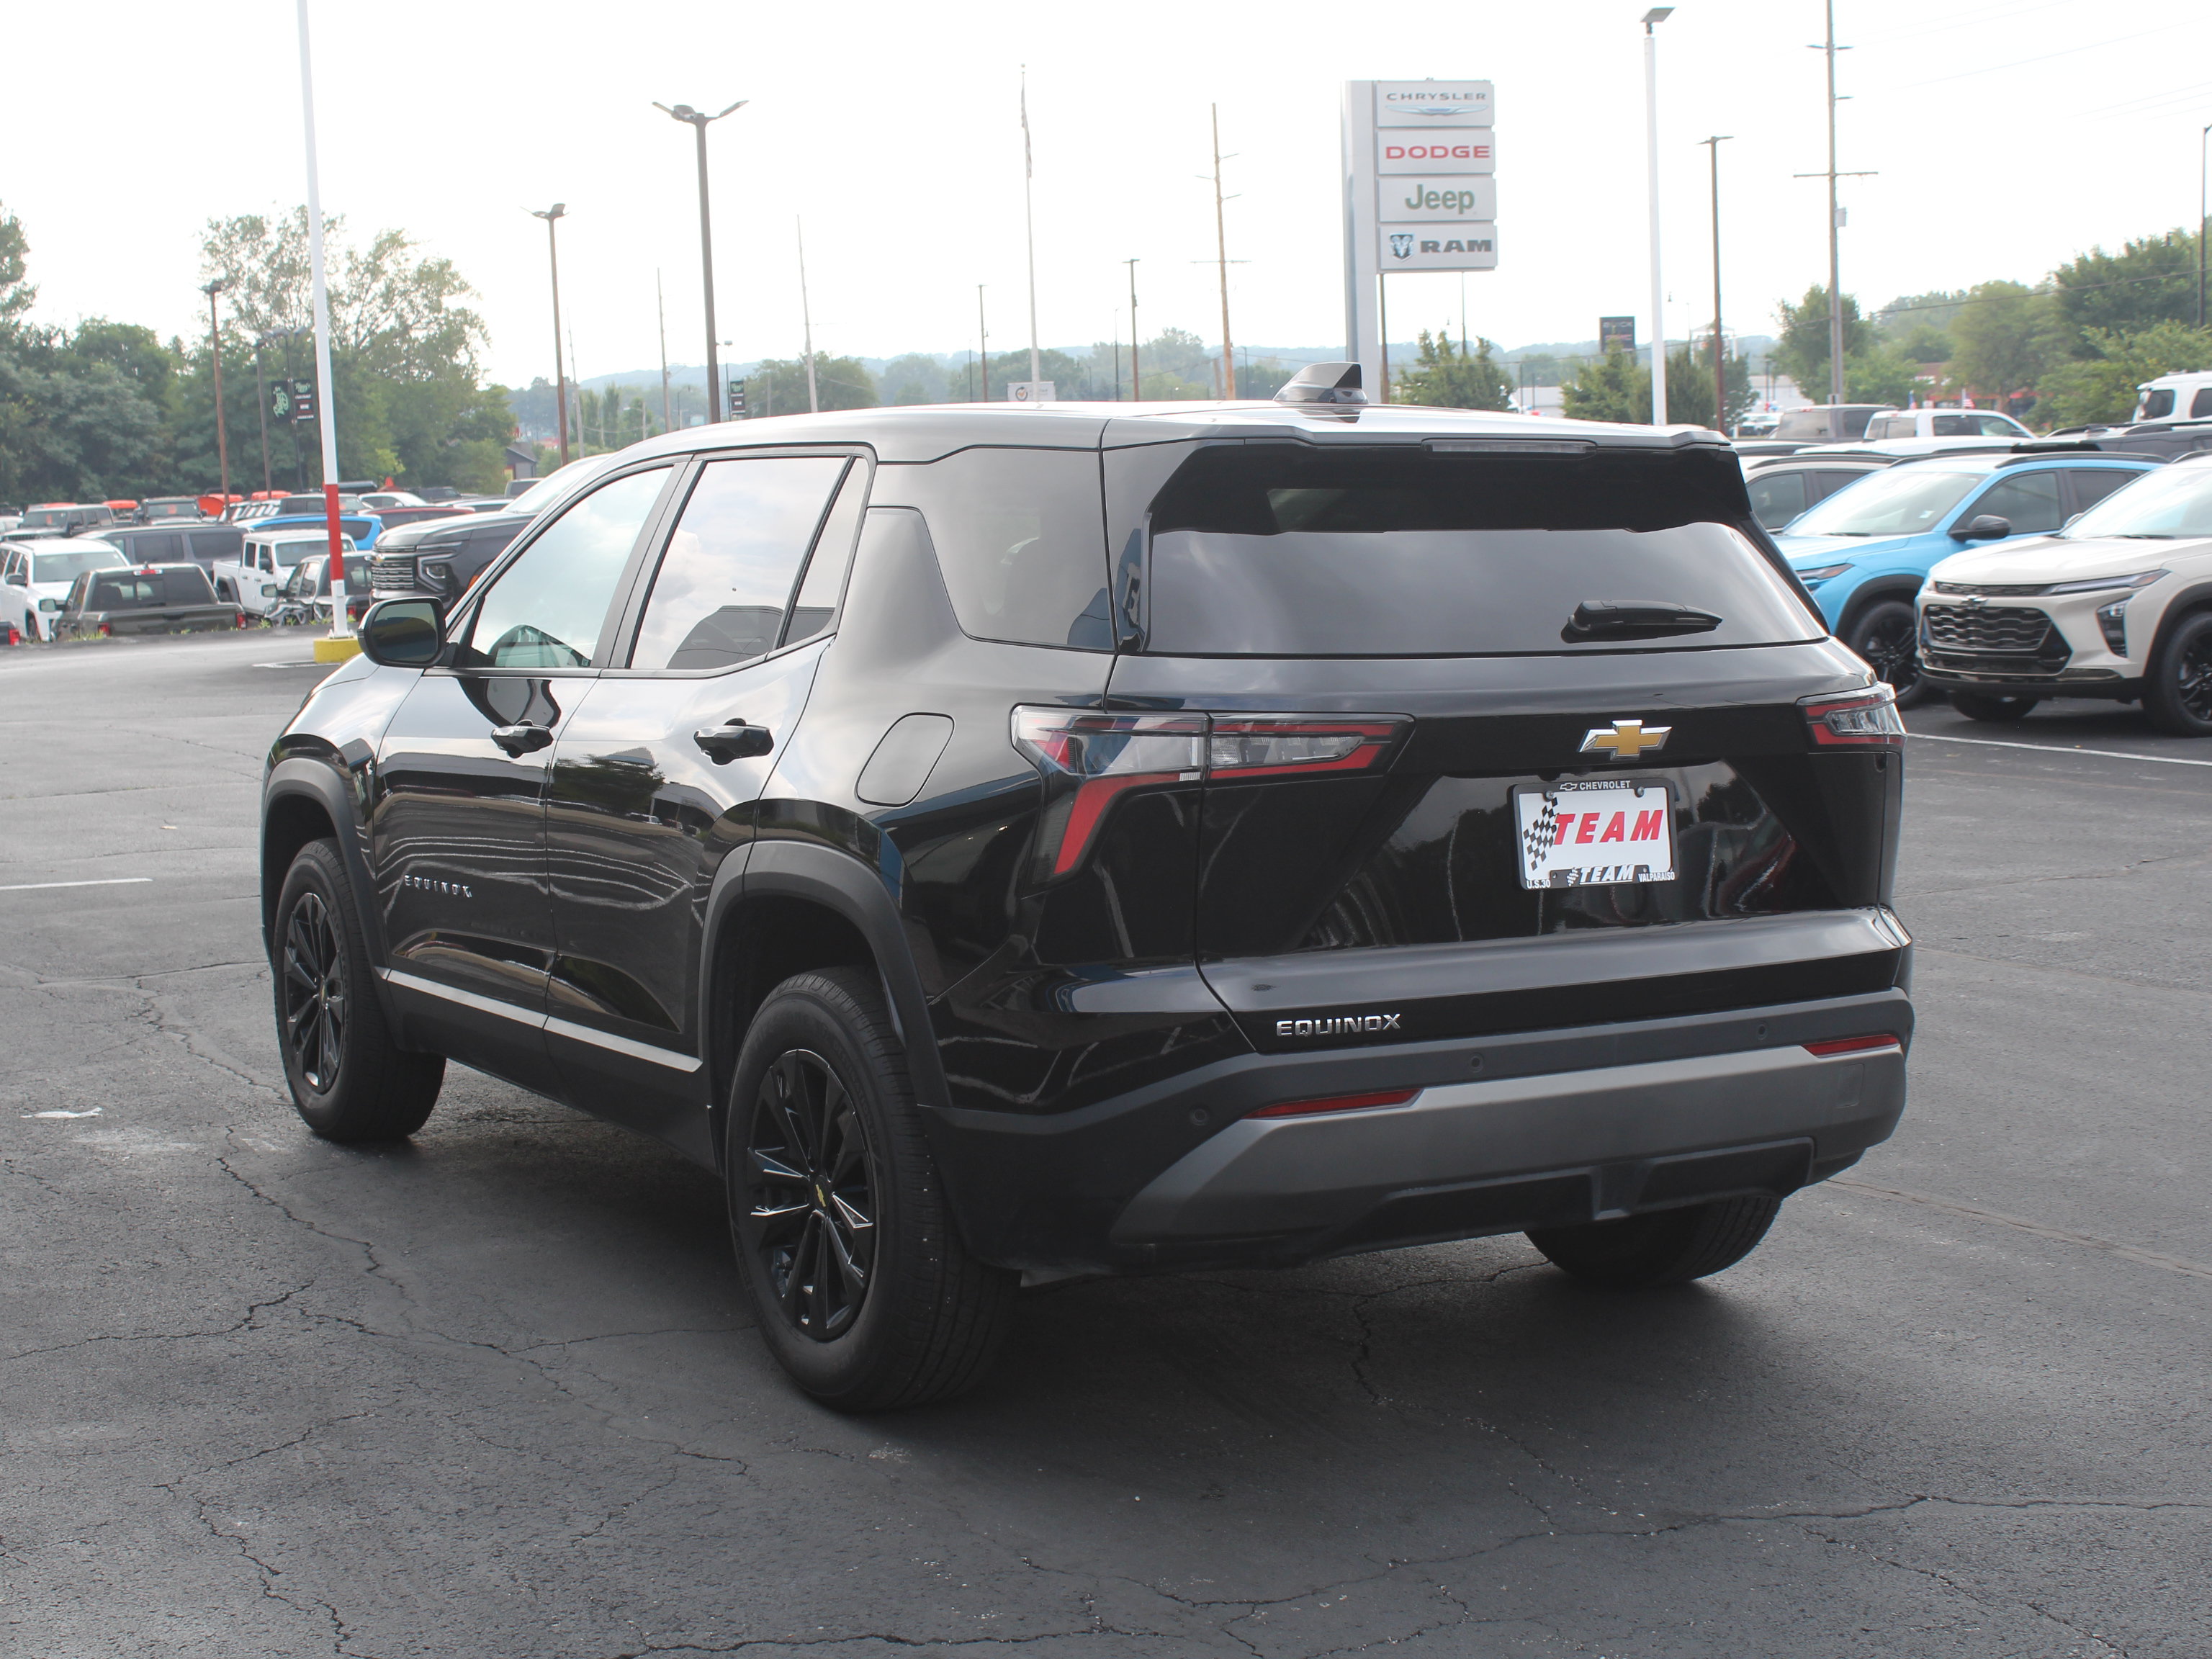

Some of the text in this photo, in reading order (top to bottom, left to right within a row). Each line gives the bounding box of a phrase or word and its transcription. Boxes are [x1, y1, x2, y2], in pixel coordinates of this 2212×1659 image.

[1386, 92, 1486, 101] CHRYSLER
[1385, 145, 1491, 159] DODGE
[1405, 184, 1475, 215] Jeep
[1420, 240, 1493, 253] RAM
[1579, 780, 1631, 791] CHEVROLET
[1553, 809, 1664, 845] TEAM
[1579, 864, 1635, 884] TEAM
[1638, 871, 1676, 883] VALPARAISO
[404, 875, 472, 898] EQUINOX
[1276, 1013, 1401, 1037] EQUINOX
